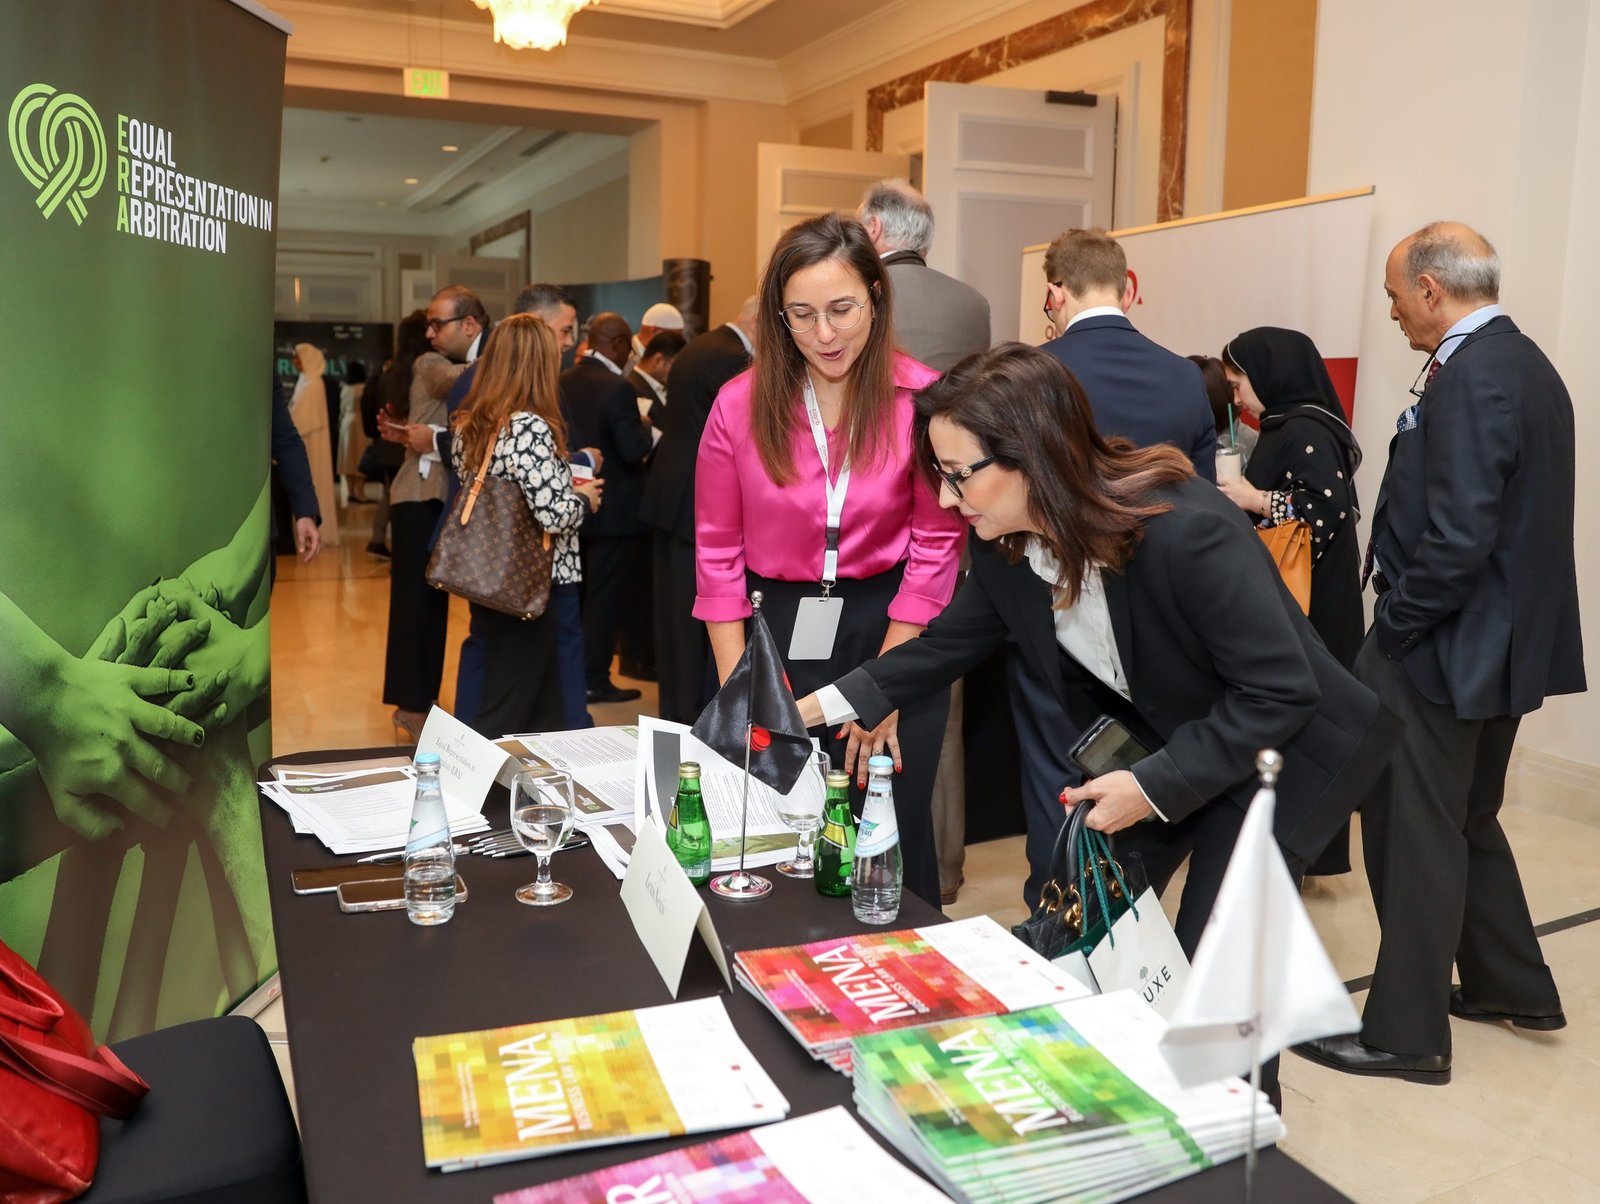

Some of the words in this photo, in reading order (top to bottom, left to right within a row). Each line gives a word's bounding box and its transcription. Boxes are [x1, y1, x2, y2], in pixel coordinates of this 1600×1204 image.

[117, 113, 176, 168] EQUAL
[116, 195, 226, 254] ARBITRATION
[117, 155, 258, 228] REPRESENTATION
[259, 198, 273, 232] IN
[812, 944, 917, 1025] MENA
[1143, 965, 1171, 1003] UXE
[498, 1032, 576, 1142] MENA
[938, 1028, 1069, 1137] MENA
